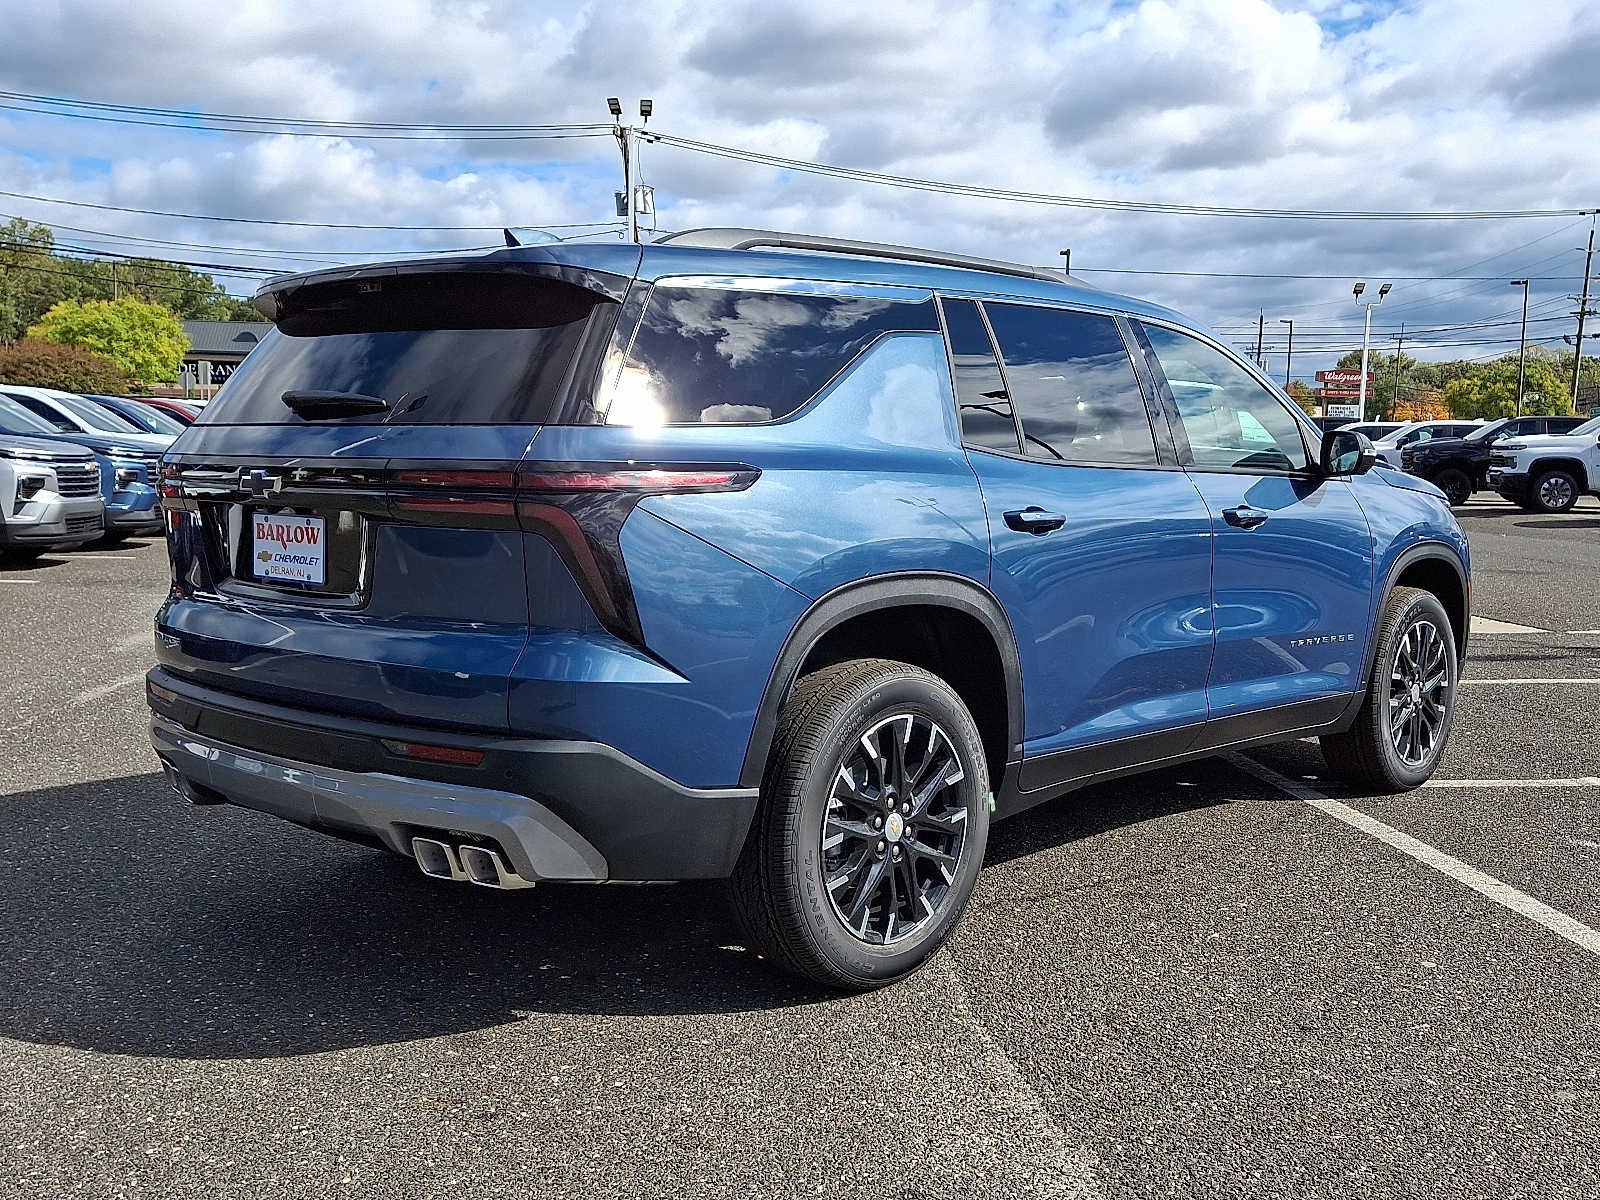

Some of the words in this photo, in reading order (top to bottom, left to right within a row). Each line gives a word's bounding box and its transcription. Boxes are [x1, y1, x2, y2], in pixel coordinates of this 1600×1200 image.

[178, 363, 236, 376] DERAN
[1324, 371, 1369, 382] Walgree
[256, 523, 320, 551] BARLOW
[274, 553, 320, 567] CHEVROLET
[296, 569, 305, 578] NJ
[1290, 633, 1355, 648] TRAVERSE
